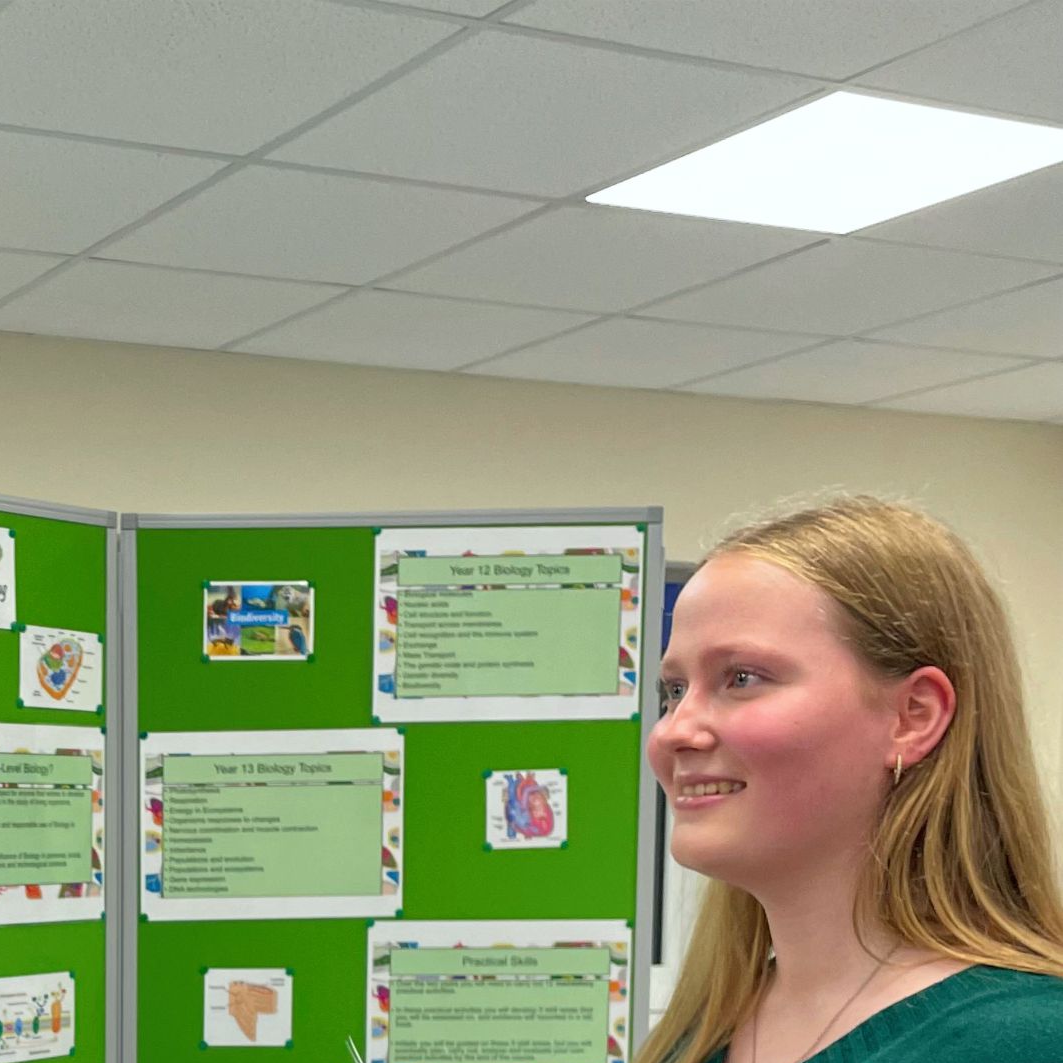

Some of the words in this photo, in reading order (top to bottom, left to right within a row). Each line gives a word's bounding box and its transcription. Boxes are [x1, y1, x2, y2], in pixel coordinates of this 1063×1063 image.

[449, 565, 473, 576] Year
[479, 566, 490, 576] 12
[494, 565, 533, 578] Biology
[536, 564, 570, 575] Topics
[230, 611, 284, 624] Biodiversity
[24, 764, 54, 776] Biology?
[214, 764, 237, 775] Year
[242, 764, 253, 774] 13
[257, 764, 296, 775] Biology
[299, 763, 332, 774] Topics
[462, 956, 507, 966] Practical
[511, 956, 538, 966] Skills
